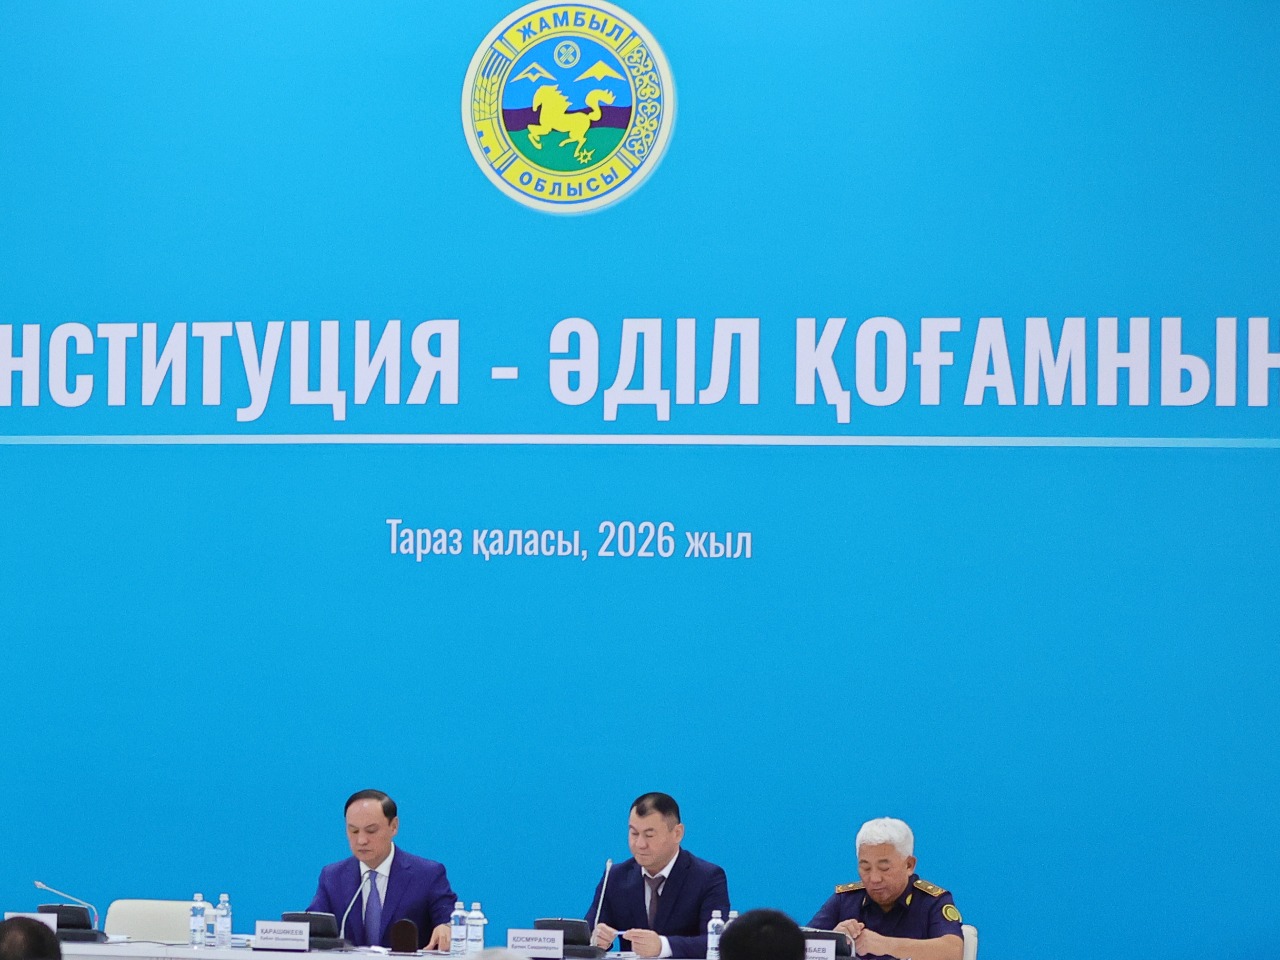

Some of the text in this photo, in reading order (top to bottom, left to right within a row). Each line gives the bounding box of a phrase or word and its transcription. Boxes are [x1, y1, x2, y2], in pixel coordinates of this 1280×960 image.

[516, 11, 625, 43] ЖАМБЫЛ
[518, 166, 620, 197] ОБЛЫСЫ
[549, 317, 760, 422] ӘДІЛ
[385, 518, 752, 563] Тараз қаласы, 2026 жыл
